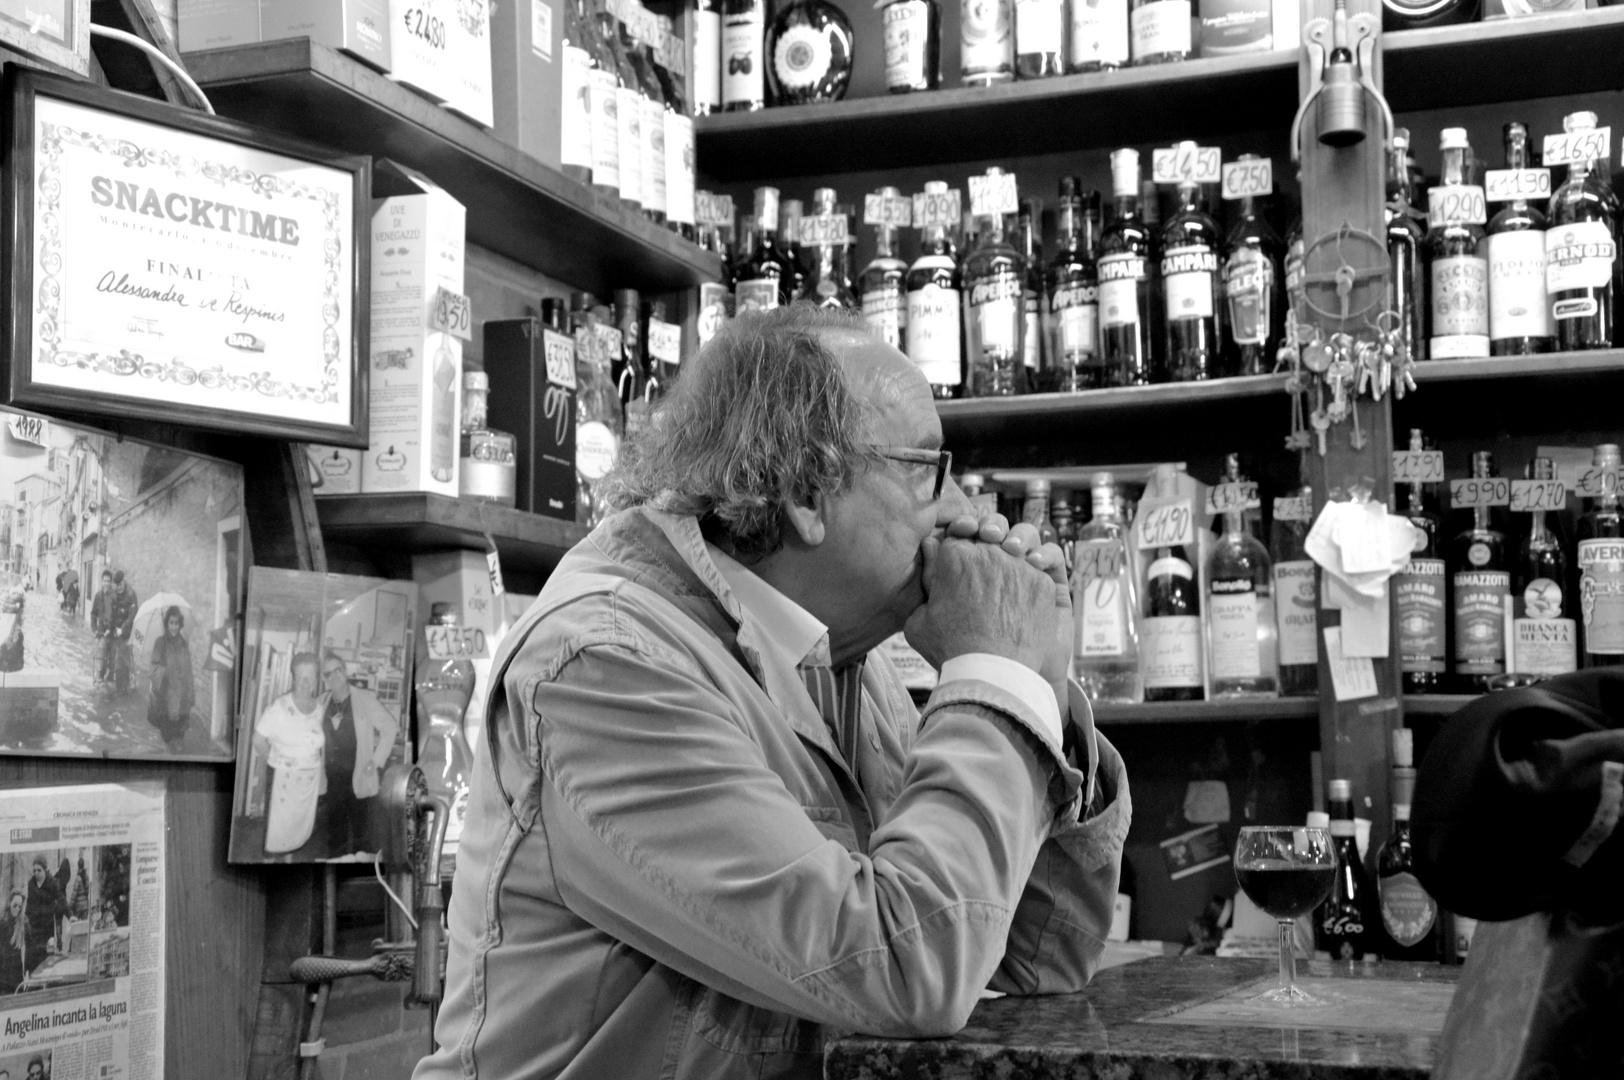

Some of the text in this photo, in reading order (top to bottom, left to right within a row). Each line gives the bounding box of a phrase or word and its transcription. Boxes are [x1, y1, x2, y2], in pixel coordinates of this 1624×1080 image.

[91, 176, 300, 246] SNACKTIME
[1548, 243, 1612, 264] ERNOD
[1161, 253, 1218, 276] CAMPARI
[146, 258, 251, 291] FINALTA
[1052, 286, 1100, 310] APERO
[228, 334, 255, 348] BAR
[1583, 546, 1624, 561] AVER
[1397, 582, 1436, 596] AMARO
[1463, 593, 1500, 605] AMARO
[1519, 623, 1569, 633] BRANCA
[1520, 633, 1569, 642] MENTA
[19, 828, 33, 840] STAR
[5, 1001, 127, 1039] Angelina incanta la laguna
